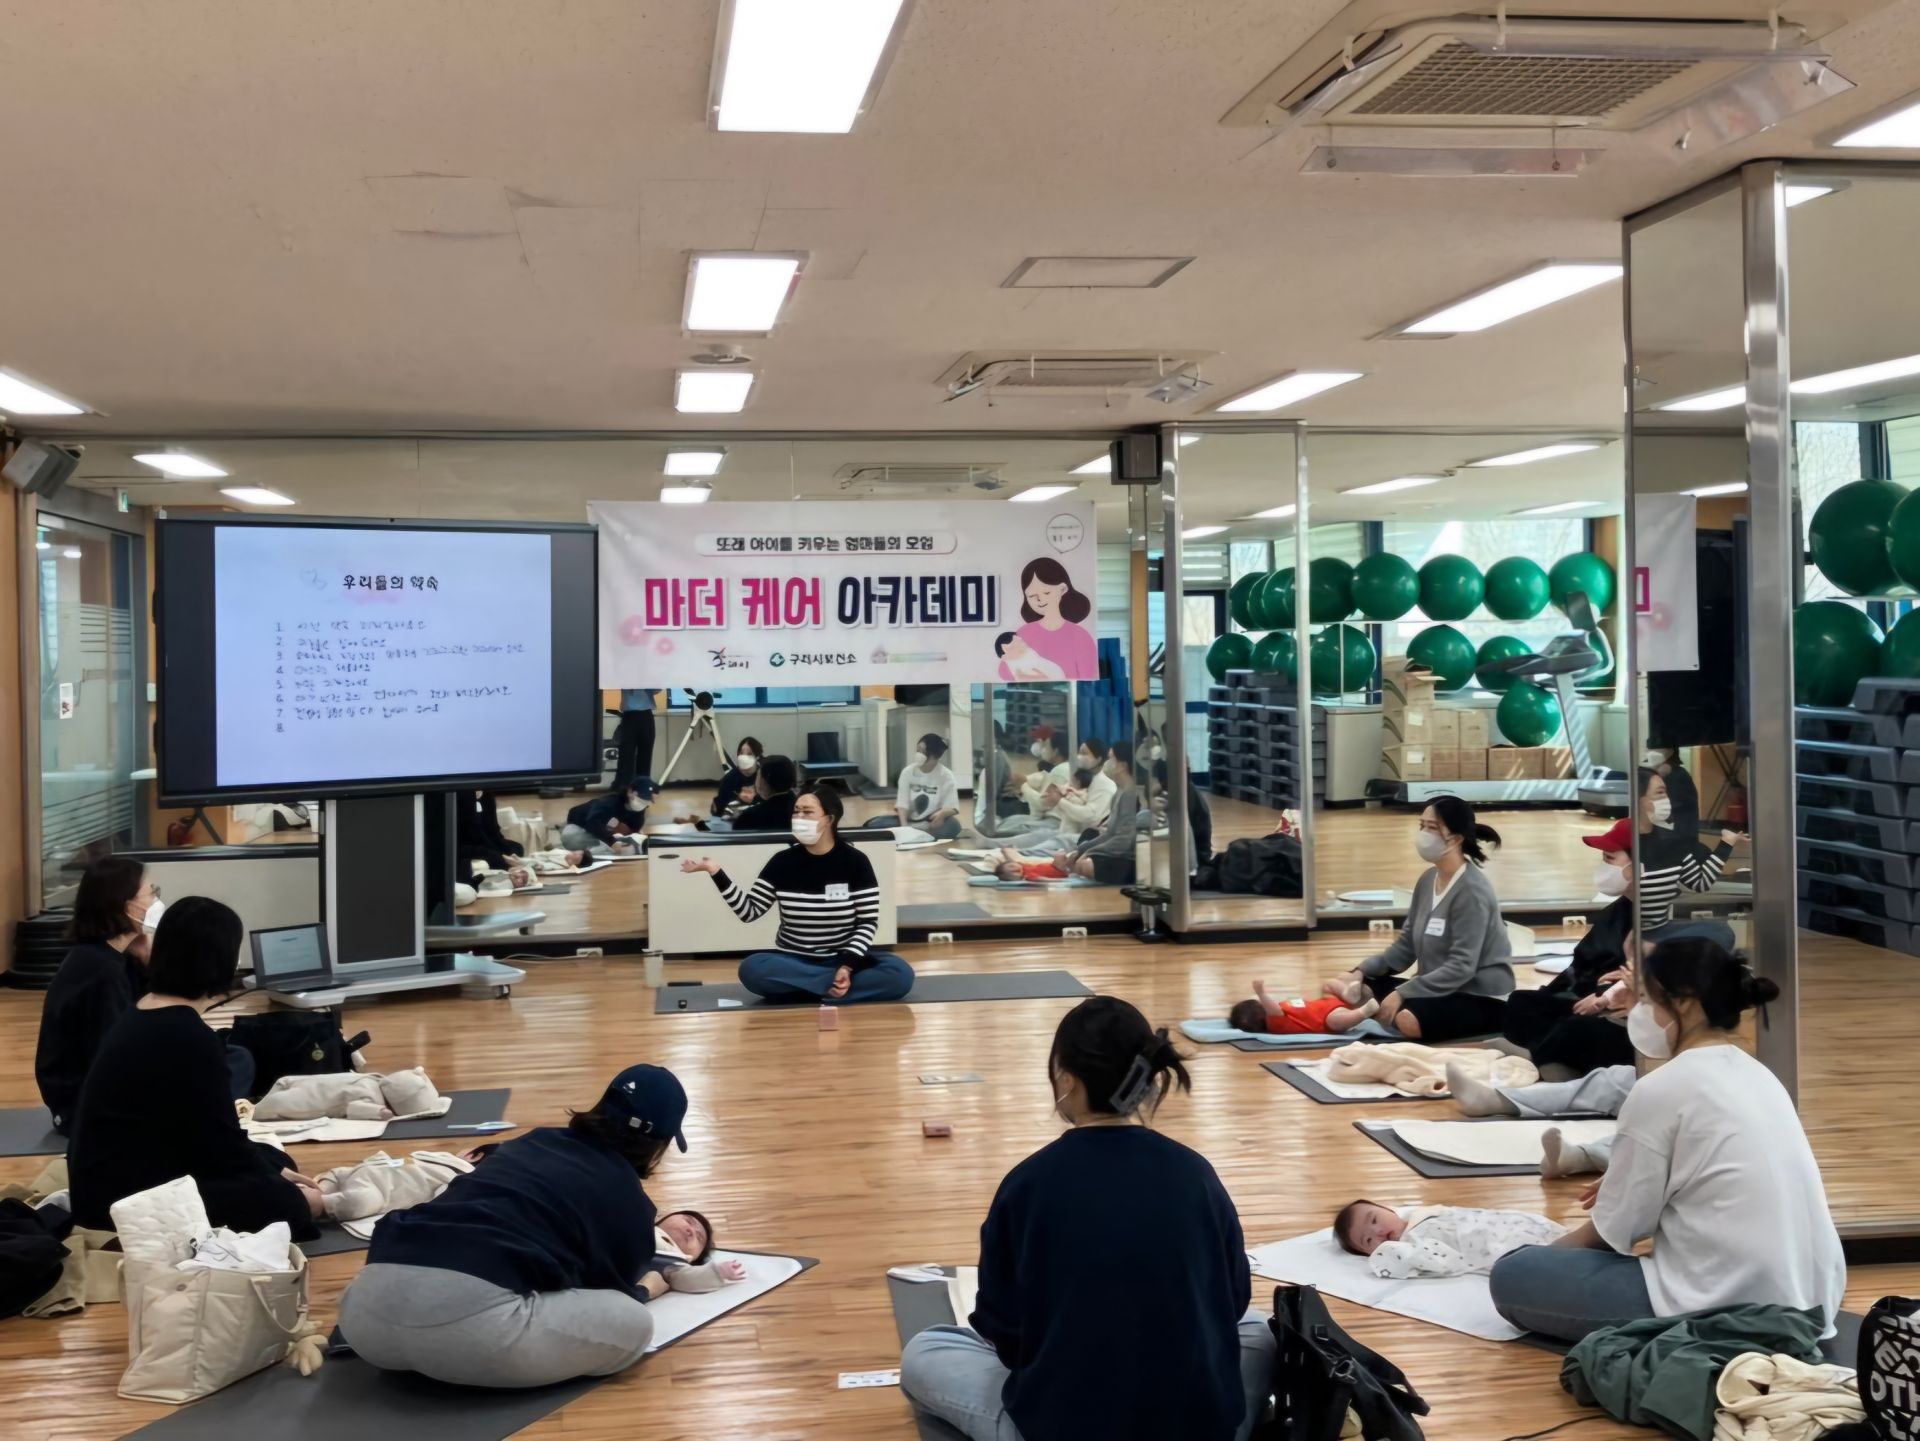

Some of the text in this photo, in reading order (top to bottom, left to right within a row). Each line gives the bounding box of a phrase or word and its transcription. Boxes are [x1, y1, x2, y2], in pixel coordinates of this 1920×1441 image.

[750, 537, 793, 552] 아이를
[797, 537, 840, 552] 키우는
[342, 574, 403, 590] 우리들의
[645, 574, 996, 626] 마더 케어 아카데미
